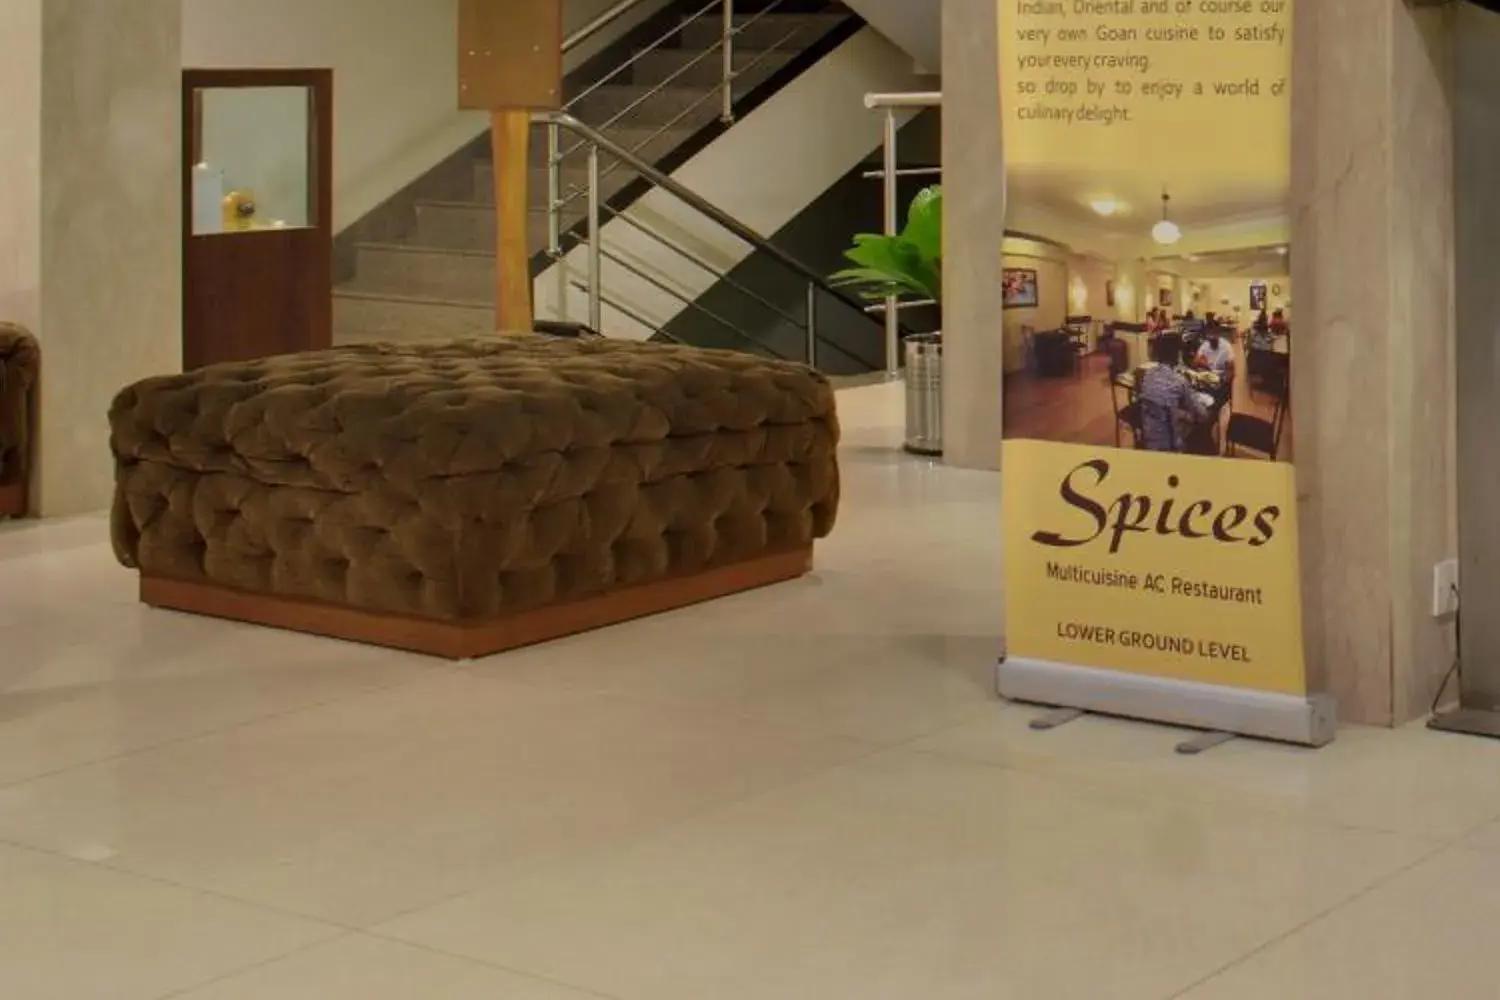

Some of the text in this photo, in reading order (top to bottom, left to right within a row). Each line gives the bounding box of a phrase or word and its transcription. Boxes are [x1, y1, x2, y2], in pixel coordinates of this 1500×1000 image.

[1073, 0, 1134, 14] Oriental
[1200, 0, 1252, 12] course
[1261, 0, 1284, 12] our
[1016, 24, 1284, 45] very own Goan cuisine to satisfy
[1017, 54, 1051, 70] your
[1053, 55, 1090, 72] every
[1017, 78, 1287, 100] so drop by to enjoy a world of
[1017, 104, 1074, 124] culinary
[1031, 459, 1280, 554] Spices
[1046, 562, 1262, 605] Multicuisine AC Restaurant
[1056, 622, 1252, 662] LOWER GROUND LEVEL
